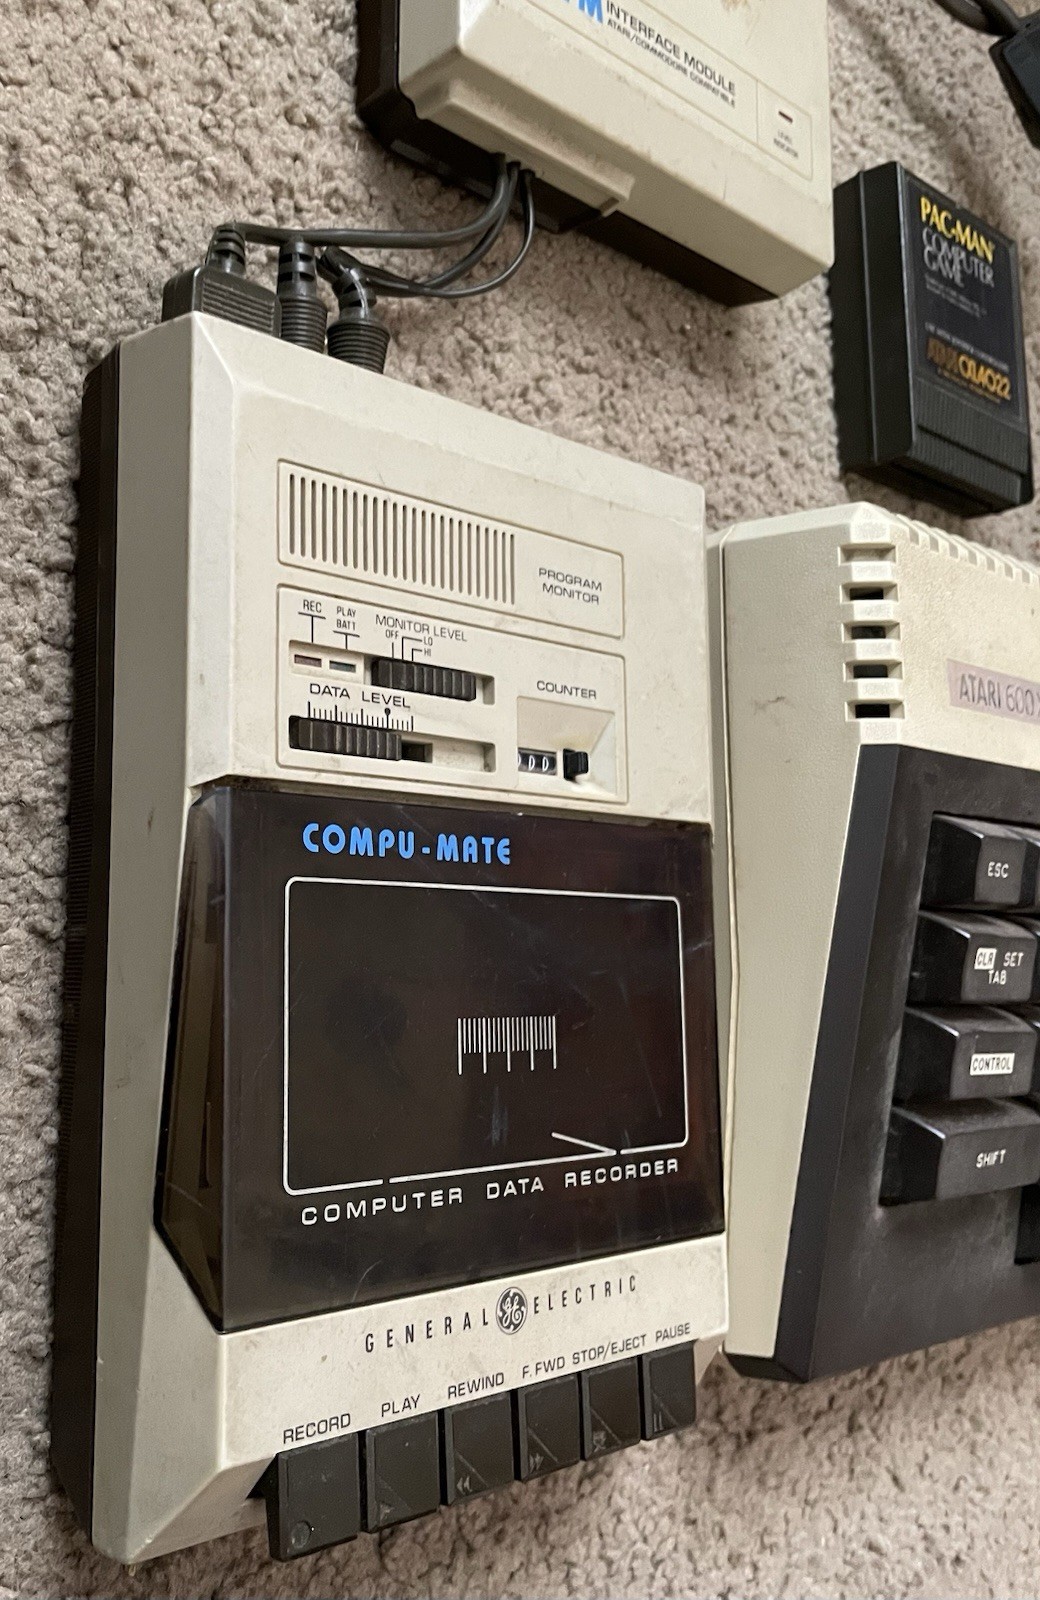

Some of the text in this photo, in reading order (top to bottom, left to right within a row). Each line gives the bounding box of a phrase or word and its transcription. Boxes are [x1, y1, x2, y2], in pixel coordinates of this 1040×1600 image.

[606, 0, 736, 97] INTERFACE MODULE
[920, 196, 993, 265] PAC-MAN
[922, 226, 995, 288] COMPUTER
[924, 245, 965, 289] GAME
[538, 567, 603, 592] PROGRAM
[303, 599, 323, 614] REC
[542, 582, 600, 606] MONITOR
[336, 605, 357, 619] PLAY
[336, 618, 356, 631] BATT
[375, 614, 468, 643] MONITOR LEVEL
[385, 628, 400, 640] OFF
[423, 636, 434, 647] LO
[423, 647, 433, 657] HI
[309, 682, 412, 709] DATA LEVEL
[536, 679, 598, 700] COUNTER
[959, 673, 1002, 710] ATARI
[302, 822, 511, 866] COMPU-MATE
[987, 860, 1010, 879] ESC
[976, 951, 1025, 968] CLR SET
[988, 969, 1008, 985] TAB
[972, 1055, 1013, 1074] CONTROL
[976, 1149, 1007, 1169] SHIFT
[301, 1157, 680, 1227] COMPUTER DATA RECORDER
[364, 1274, 638, 1354] GENERAL ELECTRIC
[655, 1321, 691, 1343] PAUSE
[572, 1333, 647, 1365] STOP/EJECT
[447, 1371, 506, 1400] REWIND
[380, 1394, 422, 1419] PLAY
[282, 1411, 352, 1445] RECORD
